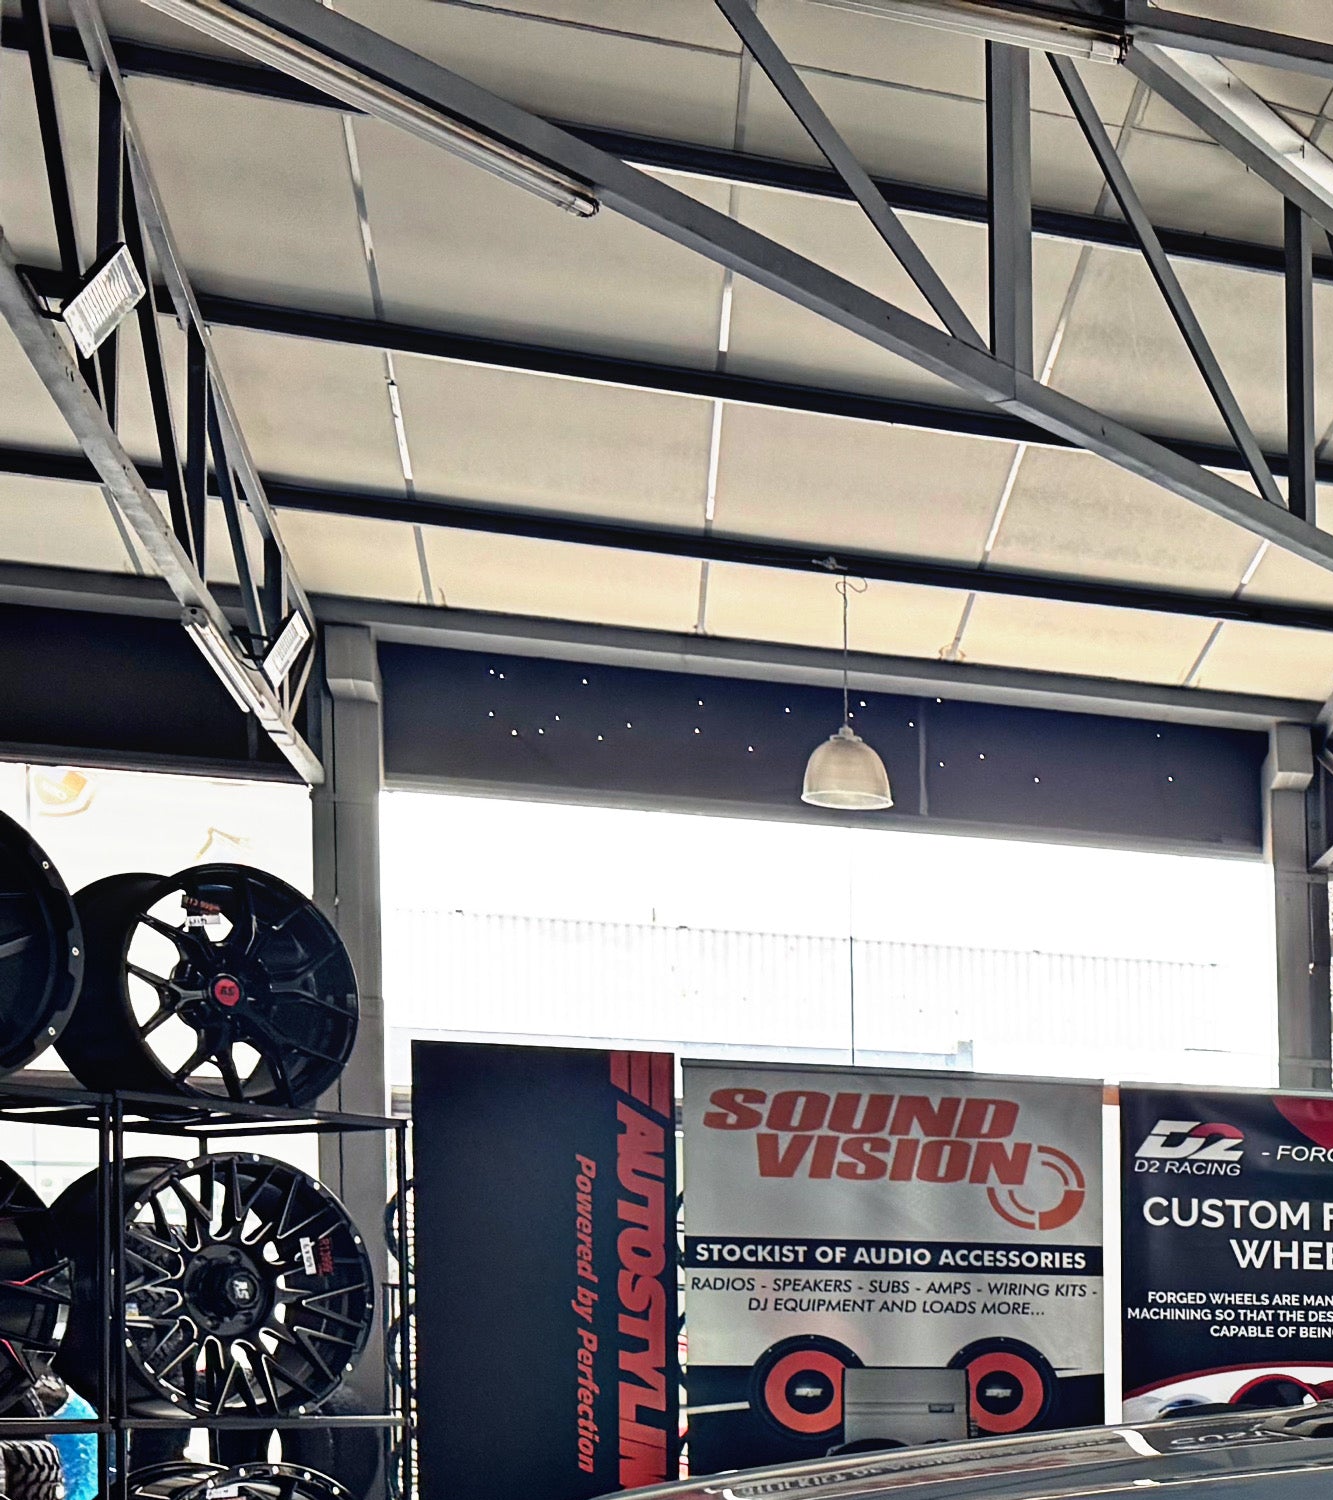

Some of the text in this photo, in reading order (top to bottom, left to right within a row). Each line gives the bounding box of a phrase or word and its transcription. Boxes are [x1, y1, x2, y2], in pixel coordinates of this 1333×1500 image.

[703, 1088, 1020, 1139] SOUND
[756, 1133, 1033, 1185] VISION
[1134, 1160, 1241, 1176] D2 RACING
[1143, 1196, 1310, 1231] CUSTOM
[696, 1243, 1087, 1269] STOCKIST OF AUDIO ACCESSORIES
[617, 1101, 668, 1491] AUTOSTYLIN
[691, 1277, 1088, 1298] RADIOS SPEAKERS SUBS AMPS WIRING KITS
[1148, 1291, 1207, 1304] FORGED
[1207, 1293, 1270, 1306] WHEELS
[1272, 1294, 1300, 1307] ARE
[571, 1154, 601, 1473] Powered by Perfection
[748, 1297, 1045, 1317] DJ EQUIPMENT AND LOADS MORE...
[1127, 1308, 1212, 1321] MACHINING
[1215, 1309, 1235, 1321] SO
[1237, 1309, 1276, 1322] THAT
[1277, 1310, 1306, 1322] THE
[1210, 1325, 1276, 1338] CAPABLE
[1278, 1326, 1298, 1338] OF
